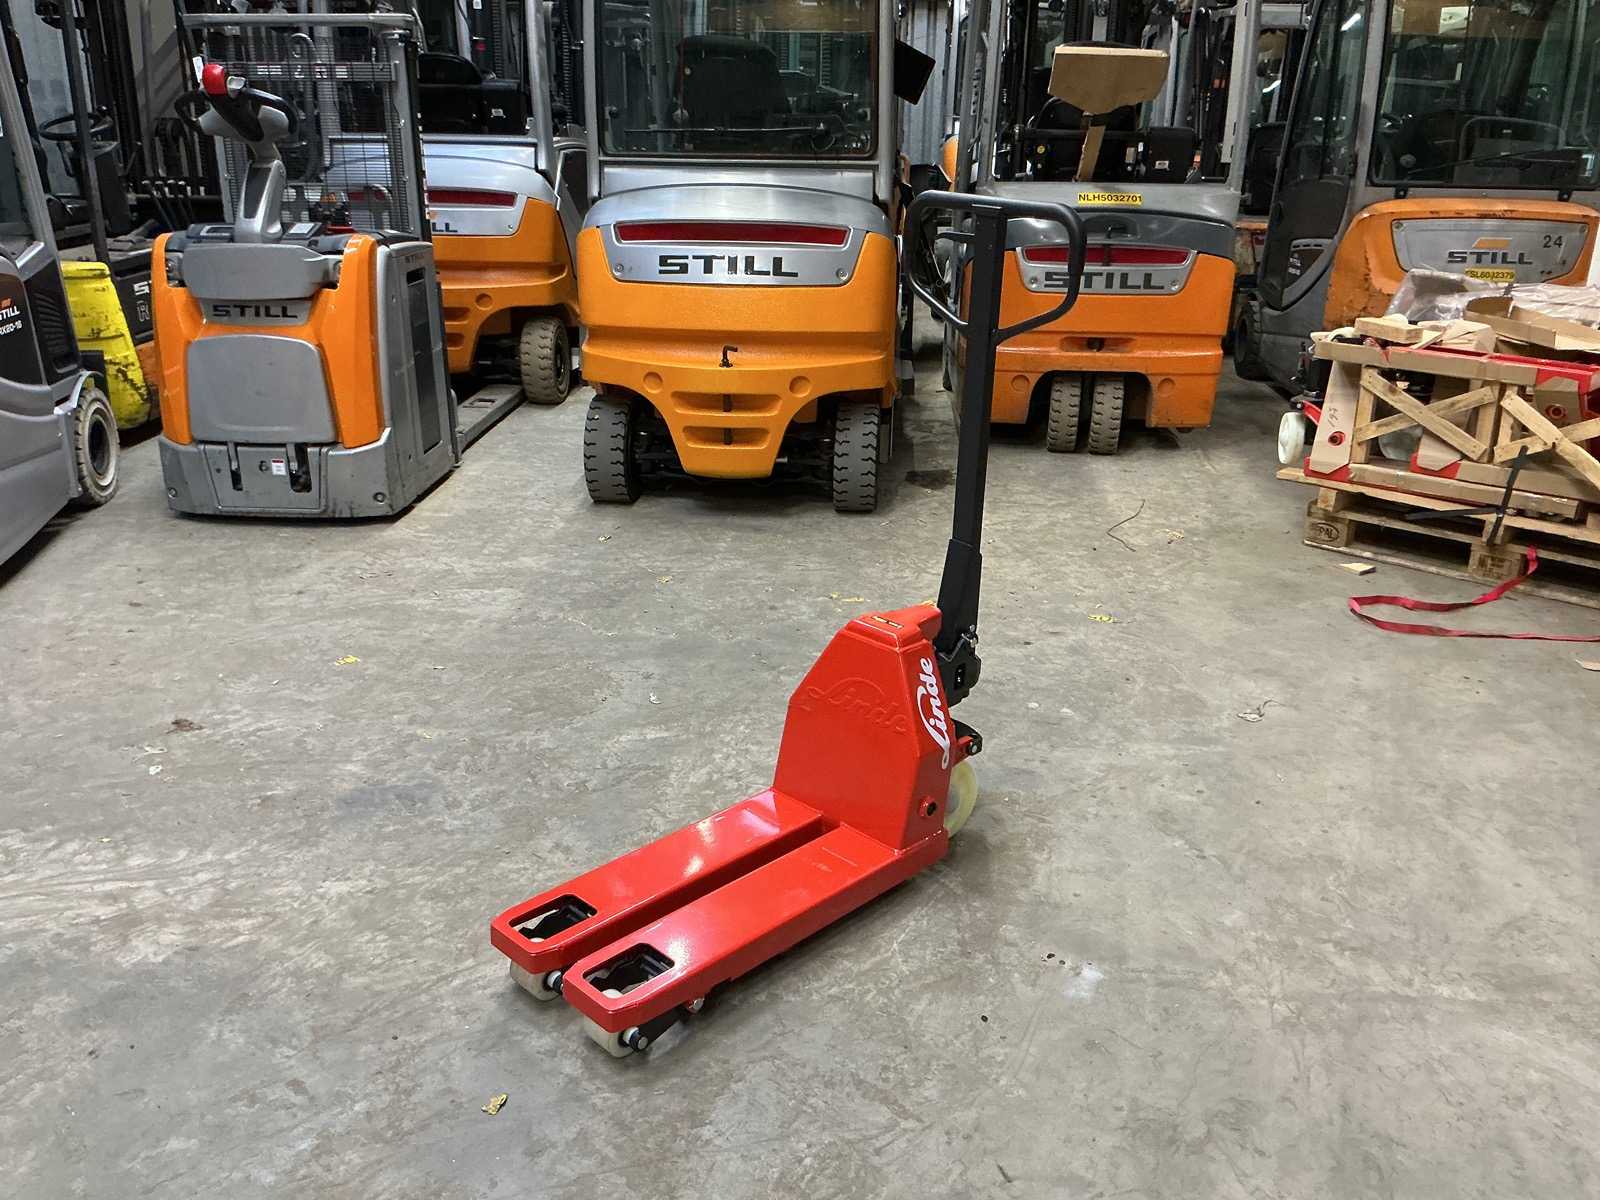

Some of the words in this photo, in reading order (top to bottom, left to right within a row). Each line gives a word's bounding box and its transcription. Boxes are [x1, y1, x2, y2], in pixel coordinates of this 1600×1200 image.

[1078, 193, 1143, 203] NLH5032701
[1543, 234, 1563, 249] 24
[658, 254, 799, 278] STILL
[1447, 250, 1534, 266] STILL
[1044, 271, 1165, 291] STILL
[212, 303, 298, 320] STILL
[916, 656, 951, 771] Linde
